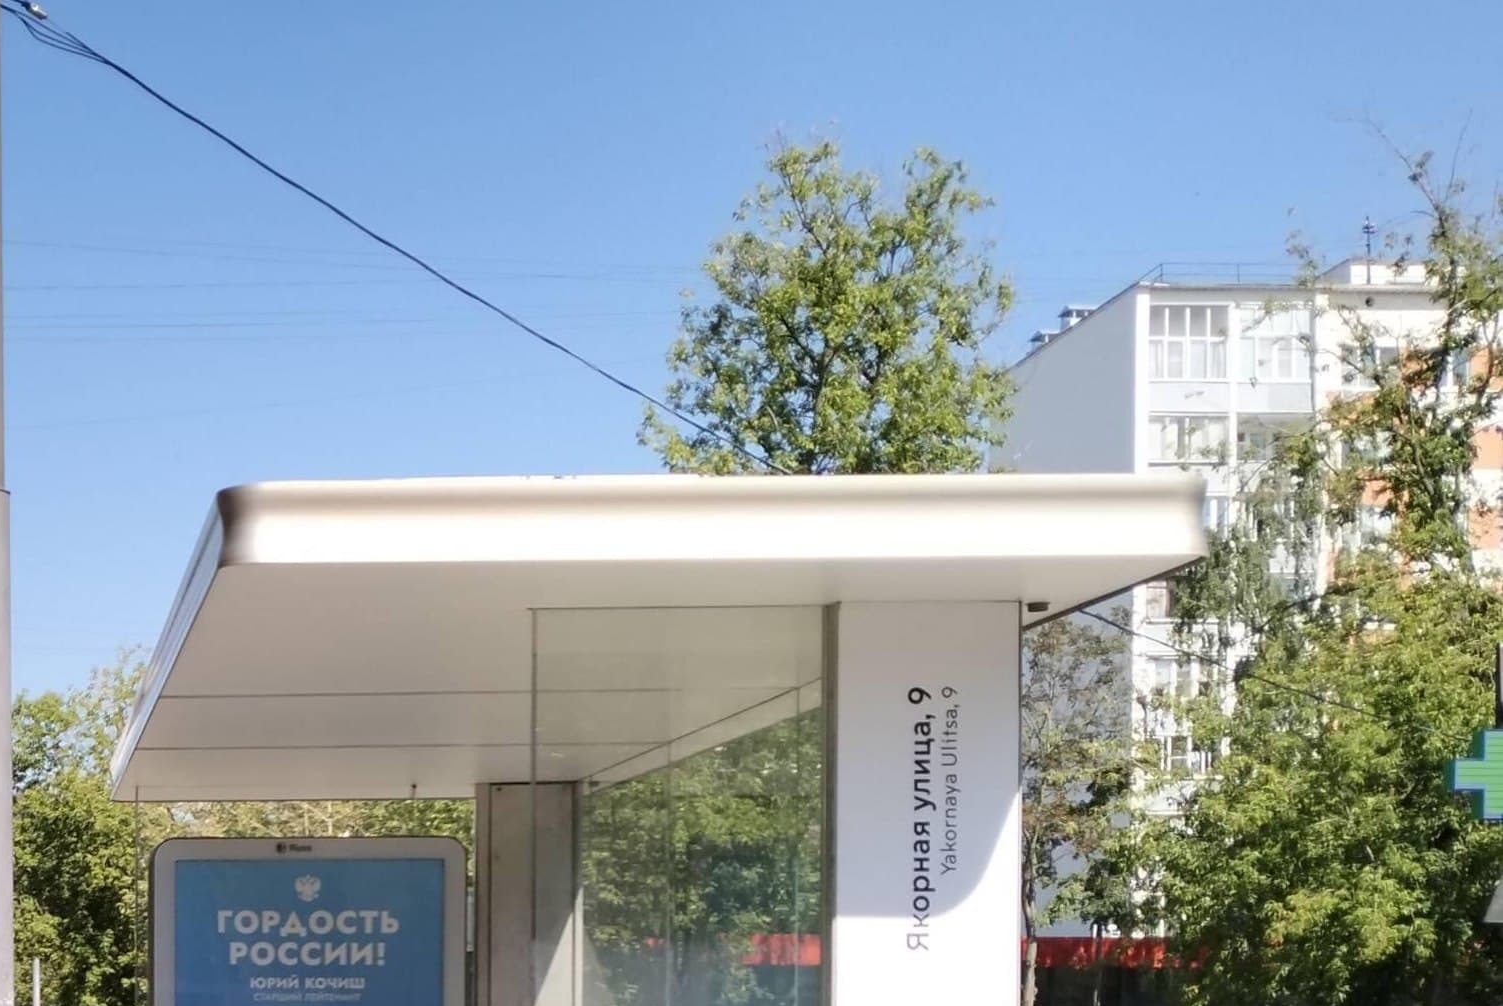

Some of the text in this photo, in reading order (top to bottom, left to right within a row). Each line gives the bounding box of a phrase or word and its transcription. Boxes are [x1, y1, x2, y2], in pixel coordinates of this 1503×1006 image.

[940, 686, 961, 875] Yakornaya Ulitsa, 9
[907, 687, 936, 951] Якорная улица, 9
[217, 910, 400, 937] ГОРДОСТЬ
[229, 942, 386, 966] РОССИИ!
[250, 975, 366, 989] ЮРИЙ КОЧИШ
